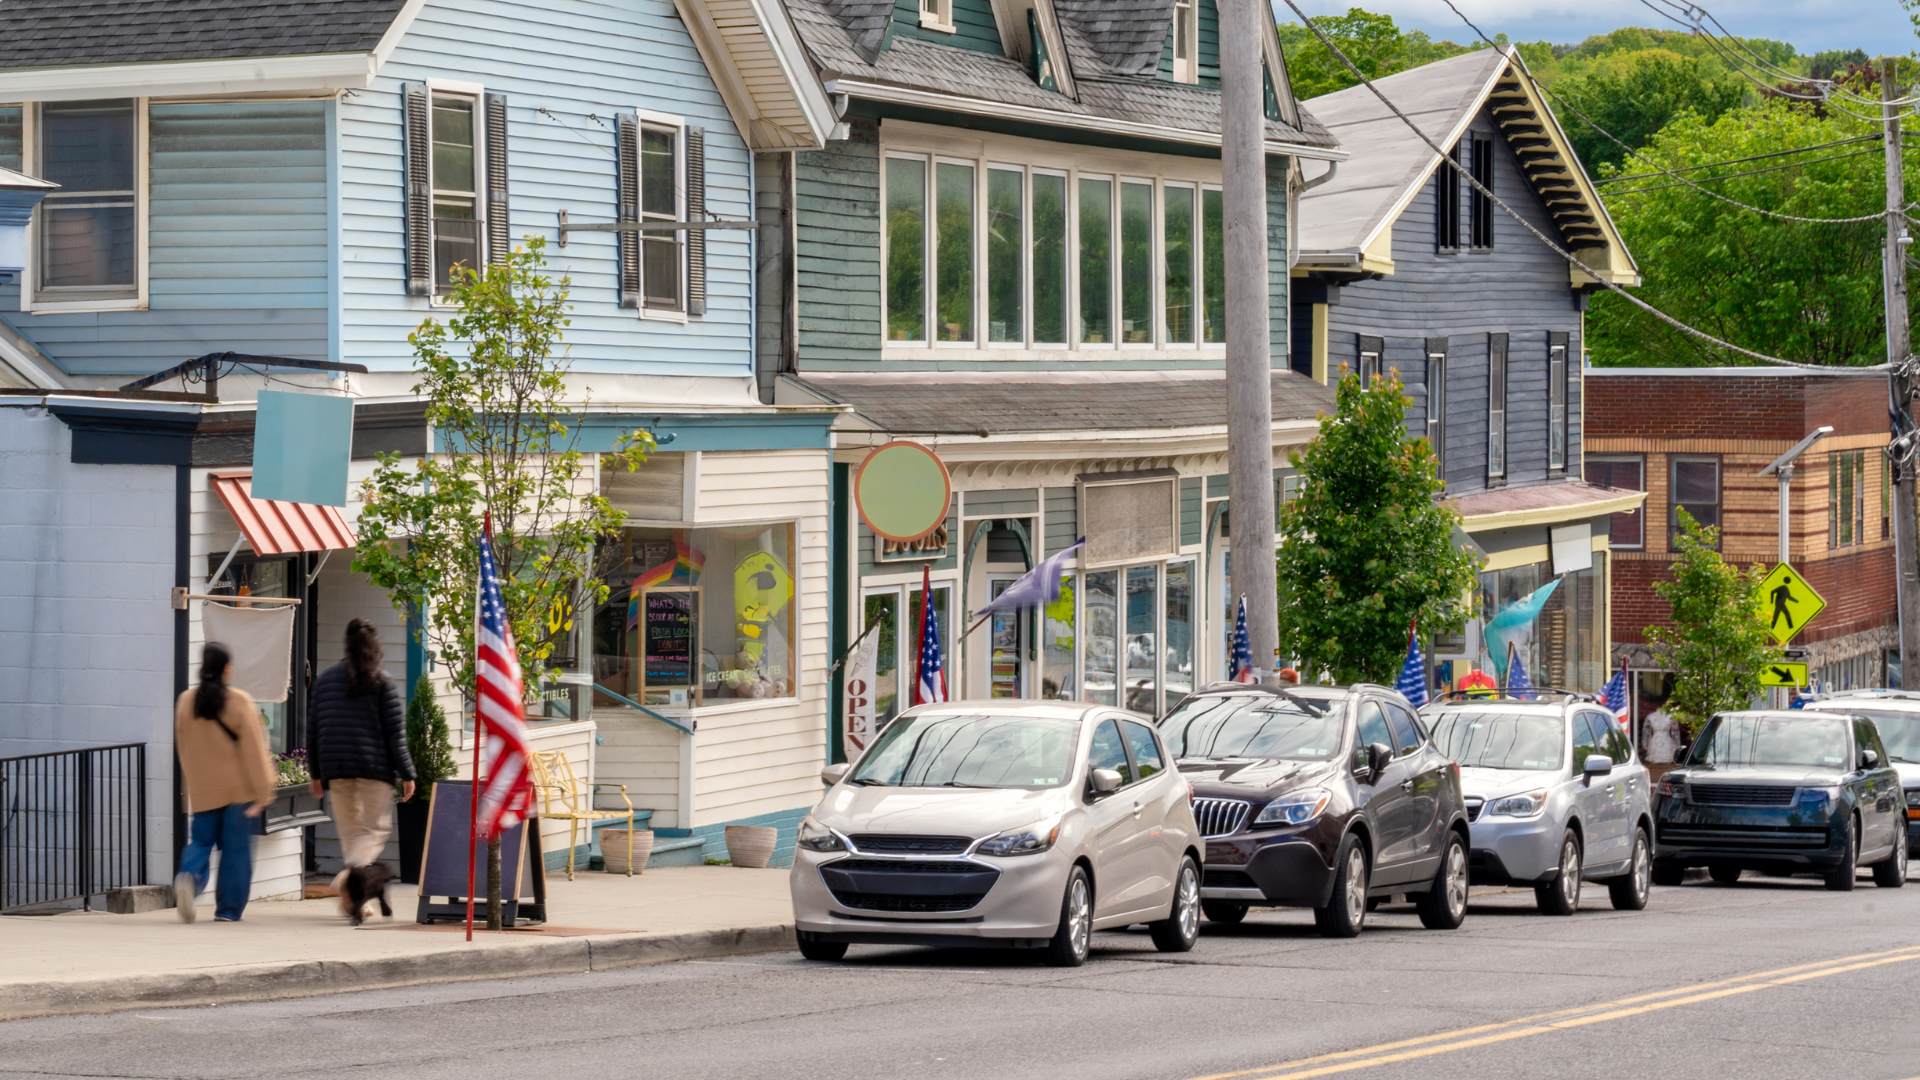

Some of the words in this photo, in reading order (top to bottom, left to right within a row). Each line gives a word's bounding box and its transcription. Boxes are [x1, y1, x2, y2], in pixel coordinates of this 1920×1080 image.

[648, 599, 674, 608] WHAT'S
[648, 612, 666, 622] SCOOP
[651, 626, 671, 637] FRESH
[705, 671, 716, 683] ICE
[743, 664, 781, 679] CHOCOATES
[847, 679, 868, 752] OPEN
